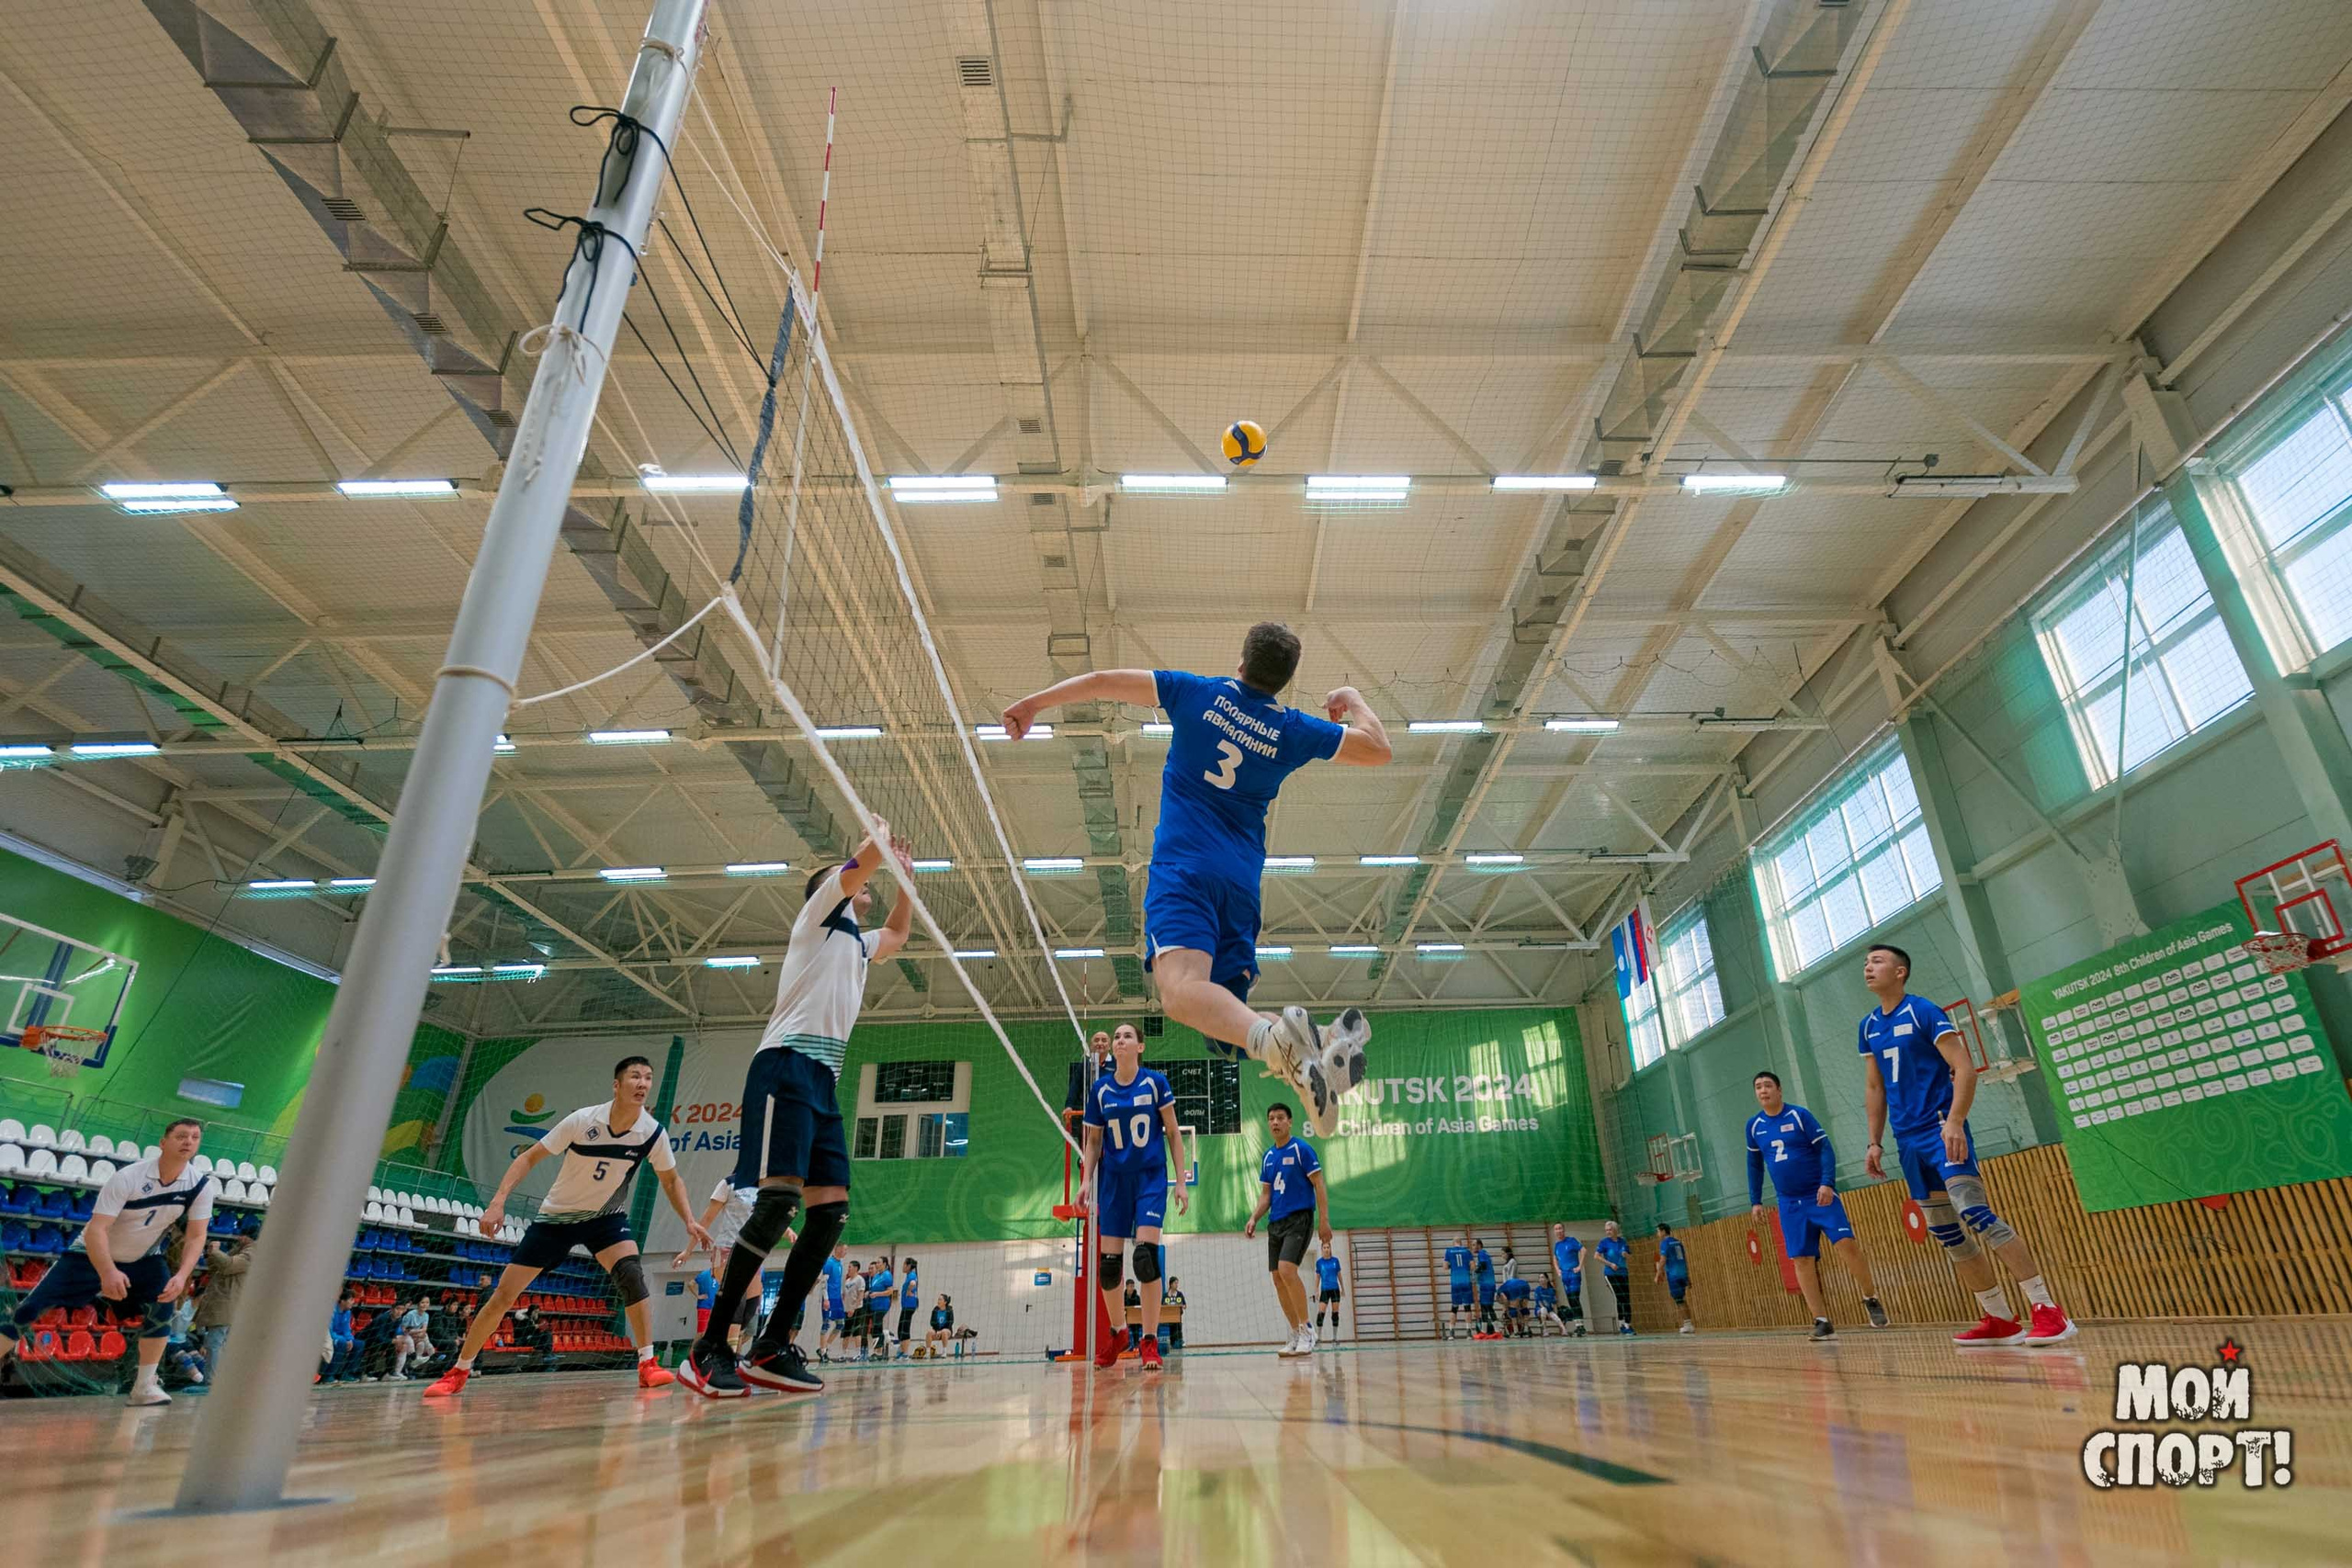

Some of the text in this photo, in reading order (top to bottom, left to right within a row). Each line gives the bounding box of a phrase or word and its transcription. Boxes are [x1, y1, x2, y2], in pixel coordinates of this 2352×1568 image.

[1214, 694, 1281, 741] ПОЛЯРНЫЕ
[1203, 710, 1278, 759] АВИАЛИНИИ
[1204, 739, 1243, 790] 3
[2052, 976, 2090, 1000] YAKUTSK
[2088, 967, 2112, 986] 2024
[2129, 949, 2166, 970] Children
[2165, 942, 2177, 956] of
[2177, 935, 2199, 952] Asia
[2197, 922, 2233, 942] Games
[1883, 1045, 1900, 1084] 7
[1453, 1073, 1532, 1103] 2024
[1108, 1113, 1150, 1149] 10
[1338, 1114, 1540, 1137] Children of Asia Games
[1770, 1139, 1789, 1163] 2
[593, 1161, 611, 1181] 5
[1273, 1171, 1286, 1195] 4
[1454, 1253, 1464, 1268] 11
